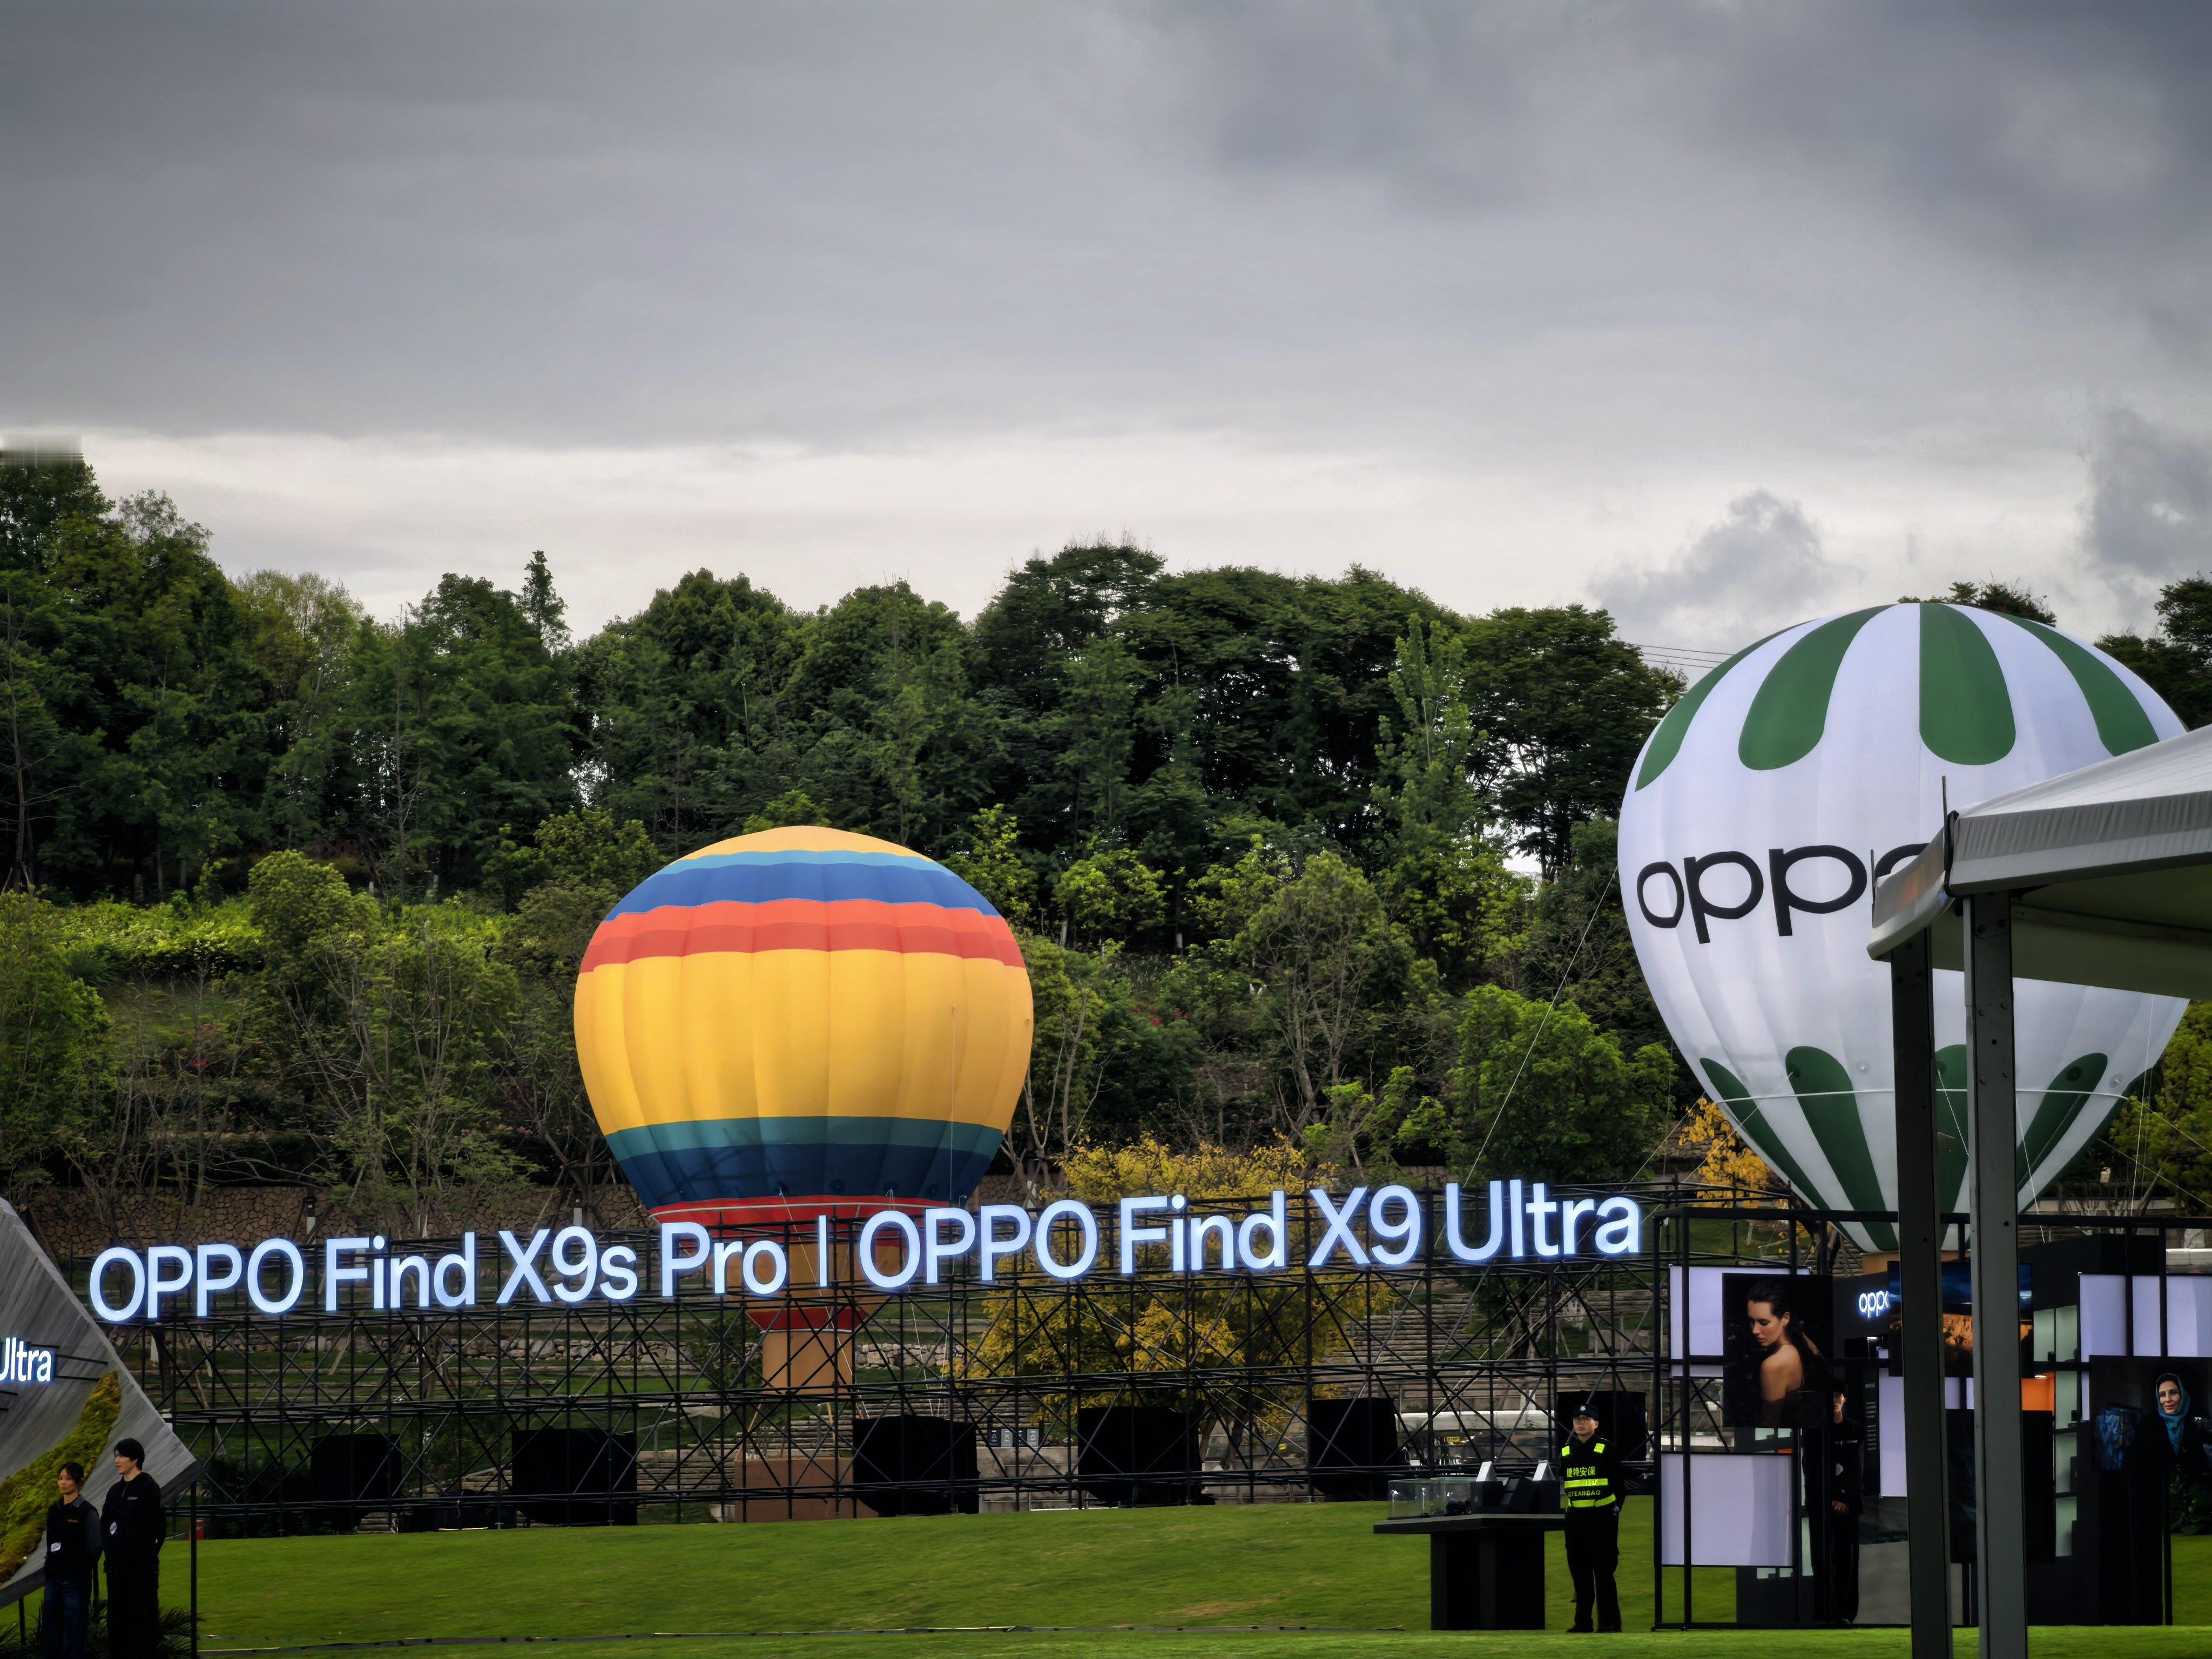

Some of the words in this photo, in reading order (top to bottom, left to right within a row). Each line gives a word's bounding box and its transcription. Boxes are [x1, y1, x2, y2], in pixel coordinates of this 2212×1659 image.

[1636, 842, 1930, 944] opp
[89, 1237, 304, 1322] OPPO
[325, 1231, 476, 1312] Find
[495, 1225, 638, 1304] X9s
[661, 1221, 787, 1297] Pro
[859, 1199, 1098, 1289] OPPO
[1120, 1190, 1286, 1274] Find
[1307, 1184, 1421, 1266] X9
[1445, 1178, 1640, 1261] Ultra
